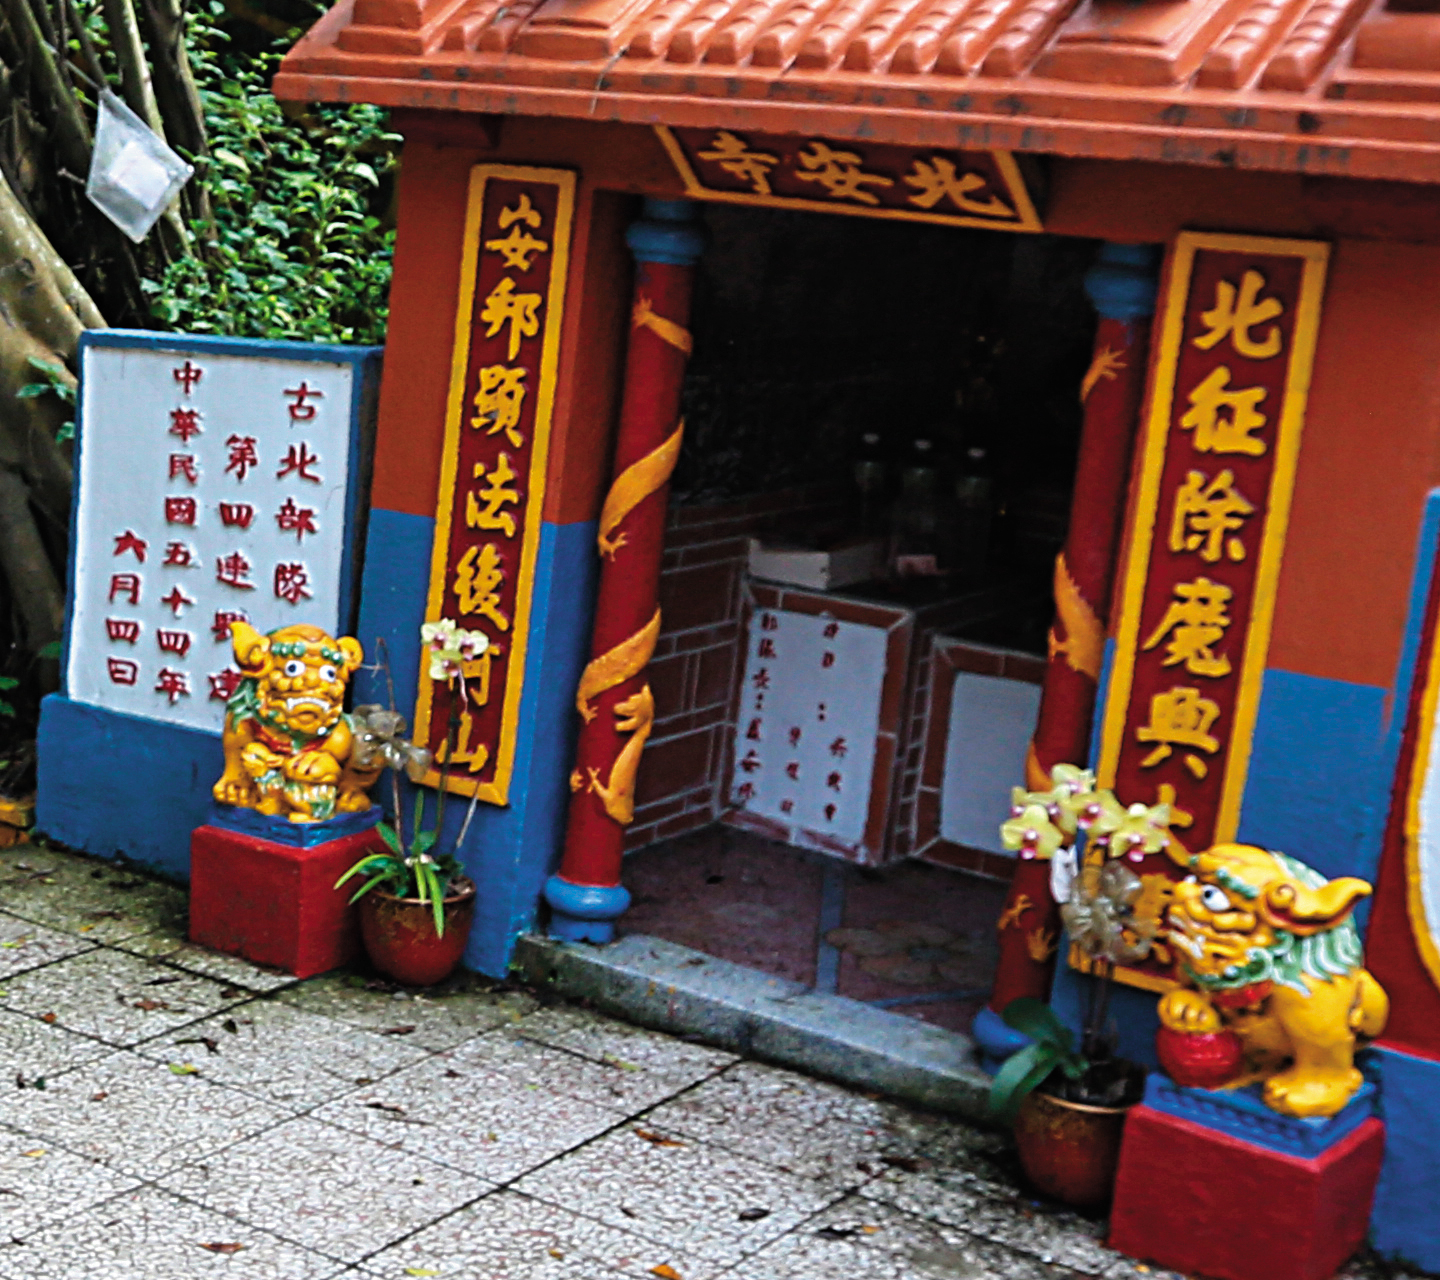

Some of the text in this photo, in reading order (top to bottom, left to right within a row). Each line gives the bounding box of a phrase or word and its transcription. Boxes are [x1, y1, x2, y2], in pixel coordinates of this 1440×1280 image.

[697, 130, 1019, 209] 北安寺
[155, 361, 202, 702] 中華民國五十四年
[274, 382, 323, 604] 古北部隊
[105, 531, 148, 686] 六月四日
[1125, 270, 1283, 963] 北征除魔興大
